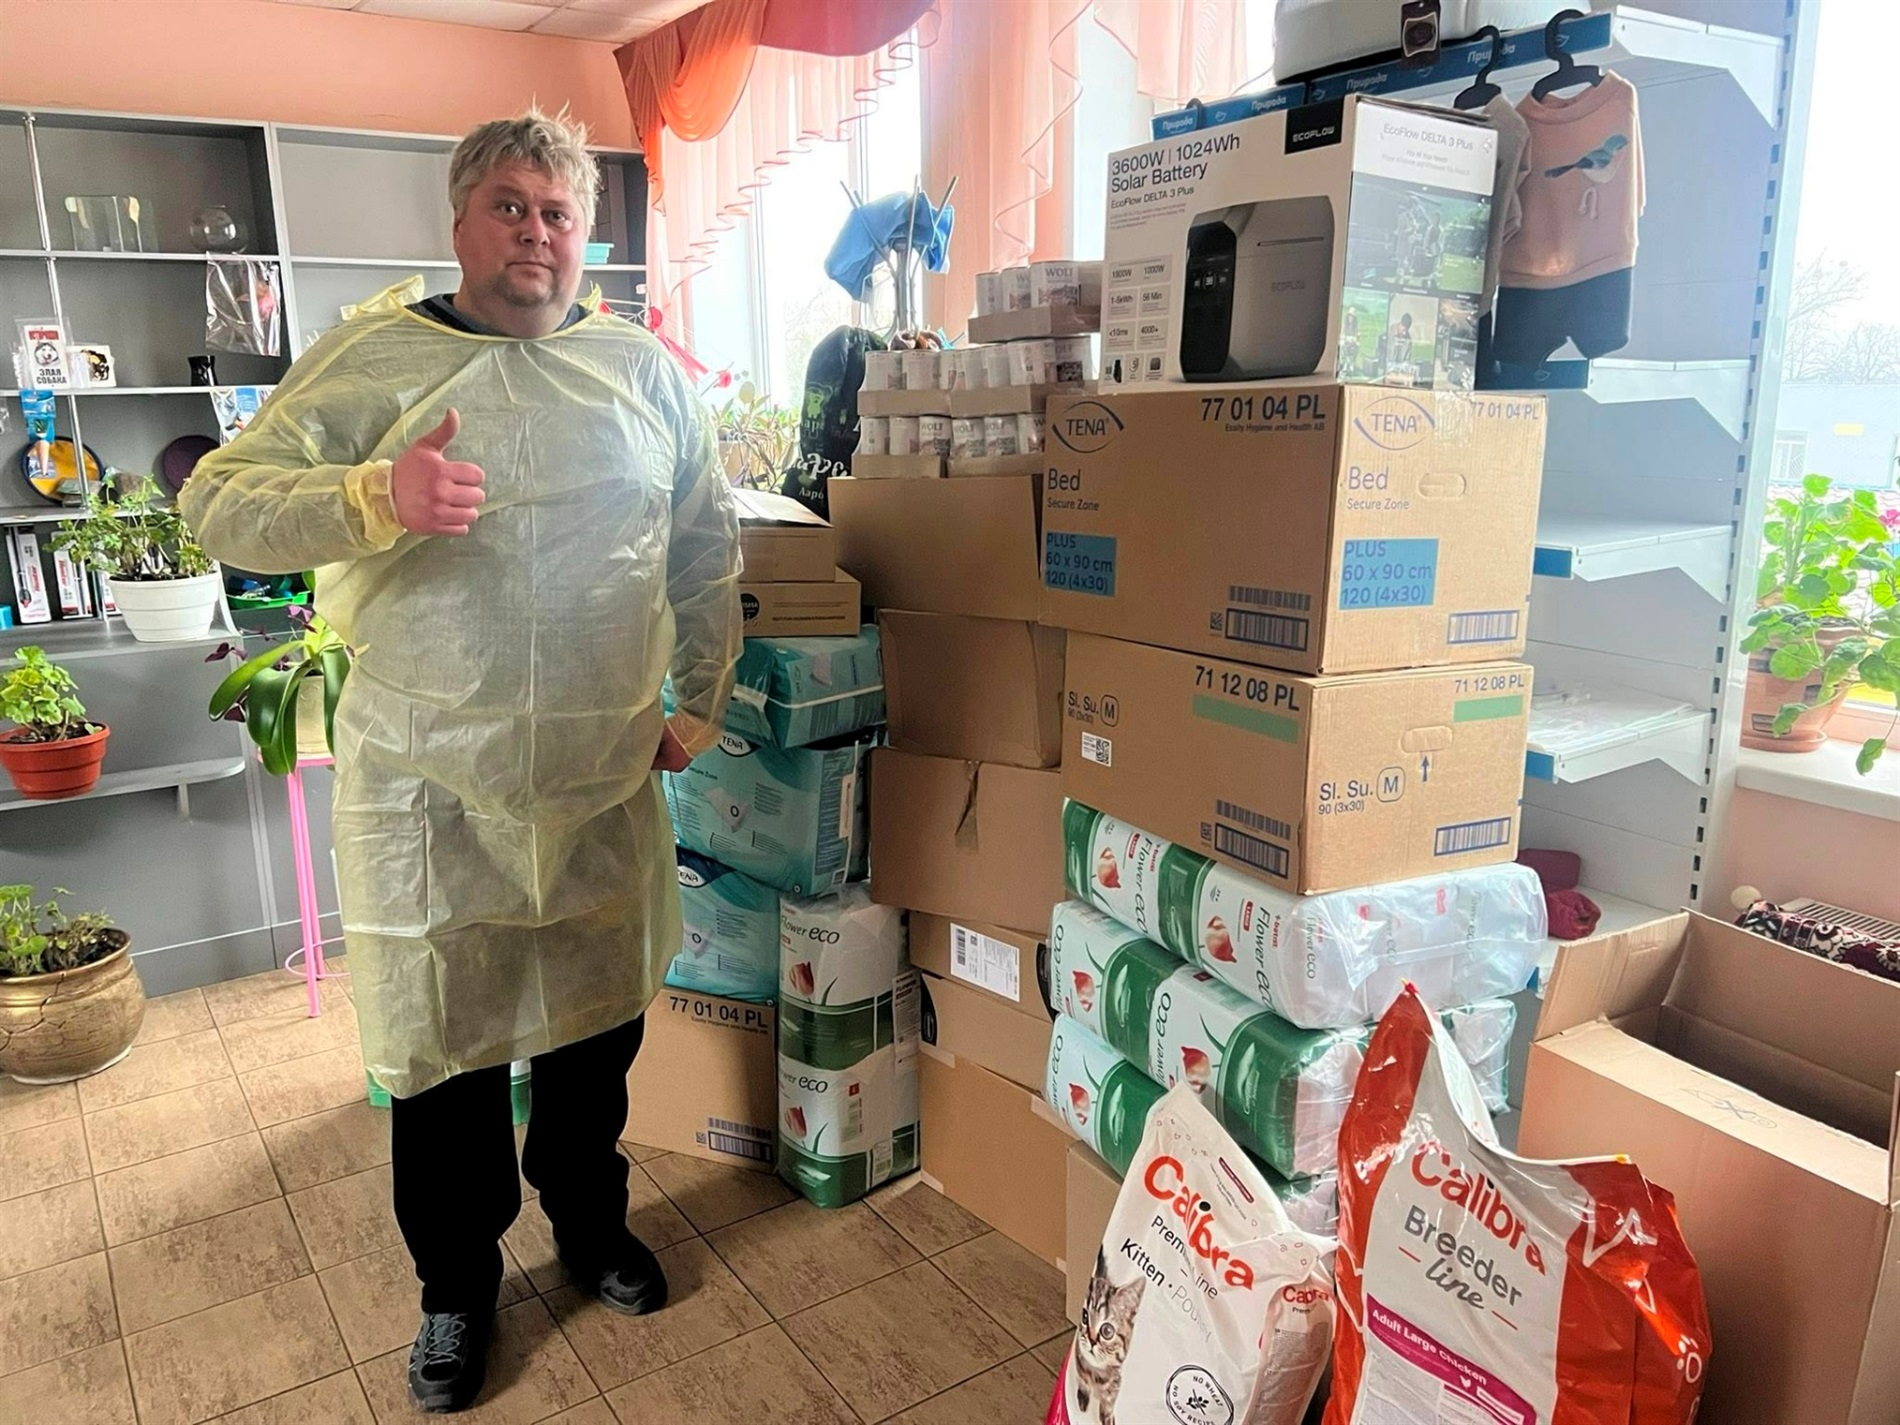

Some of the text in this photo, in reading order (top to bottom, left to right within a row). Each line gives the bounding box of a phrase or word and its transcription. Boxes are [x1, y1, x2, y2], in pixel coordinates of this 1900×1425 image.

[1467, 44, 1516, 64] Прида
[1292, 126, 1335, 143] ECOFLOW
[1383, 124, 1474, 150] EcoFlow DELTA 3 Plus
[1112, 133, 1240, 176] 3600W 1024Wh
[1111, 162, 1208, 193] Solar Battery
[1111, 186, 1194, 209] EcoFlow DELTA 3 Plus
[39, 368, 62, 376] ЗЛАЯ
[1201, 394, 1326, 422] 77 01 04 PL
[1470, 401, 1539, 420] 77 01 04 PL
[1066, 419, 1107, 436] TENA
[1225, 422, 1245, 433] Essity
[1246, 423, 1273, 433] Hygiene
[1274, 423, 1288, 432] and
[1371, 414, 1418, 432] TENA
[1048, 469, 1081, 491] Bed
[1348, 466, 1389, 490] Bed
[1047, 496, 1099, 512] Secure Zone
[1347, 498, 1409, 510] Secure Zone
[1046, 532, 1076, 548] PLUS
[1344, 541, 1386, 559] PLUS
[1046, 552, 1113, 572] 60 x 90 cm
[1343, 563, 1433, 581] 60 x 90 cm
[1045, 570, 1108, 593] 120 (4x30)
[1342, 585, 1426, 606] 120 (4x30)
[1195, 665, 1300, 711] 71 12 08 PL
[1454, 675, 1524, 693] 71 12 08 PL
[1083, 695, 1099, 715] Su.
[1104, 703, 1115, 719] M
[722, 736, 743, 750] TENA
[1319, 776, 1399, 801] Sl. Su. M
[1318, 800, 1364, 816] 90 (3x30)
[1135, 838, 1154, 934] Flower eco
[808, 927, 840, 945] eco
[1054, 924, 1064, 965] eco
[1255, 907, 1277, 1012] Flower eco
[1307, 953, 1316, 979] eco
[669, 996, 768, 1028] 77 01 04 PL
[1155, 992, 1171, 1085] lower eco
[1053, 1035, 1063, 1076] eco
[799, 1076, 828, 1093] eco
[1411, 1141, 1546, 1275] Calibra
[1144, 1155, 1254, 1291] Calibra
[1120, 1238, 1165, 1287] Kitten
[1404, 1205, 1522, 1306] Breeder
[1196, 1271, 1219, 1300] ine
[1425, 1258, 1484, 1309] line
[1373, 1310, 1401, 1333] Adult
[1404, 1327, 1437, 1353] Large
[1439, 1350, 1487, 1385] Chicken
[1172, 1385, 1179, 1398] NO
[1193, 1375, 1224, 1407] NO WHEAT
[1174, 1401, 1187, 1415] SOY
